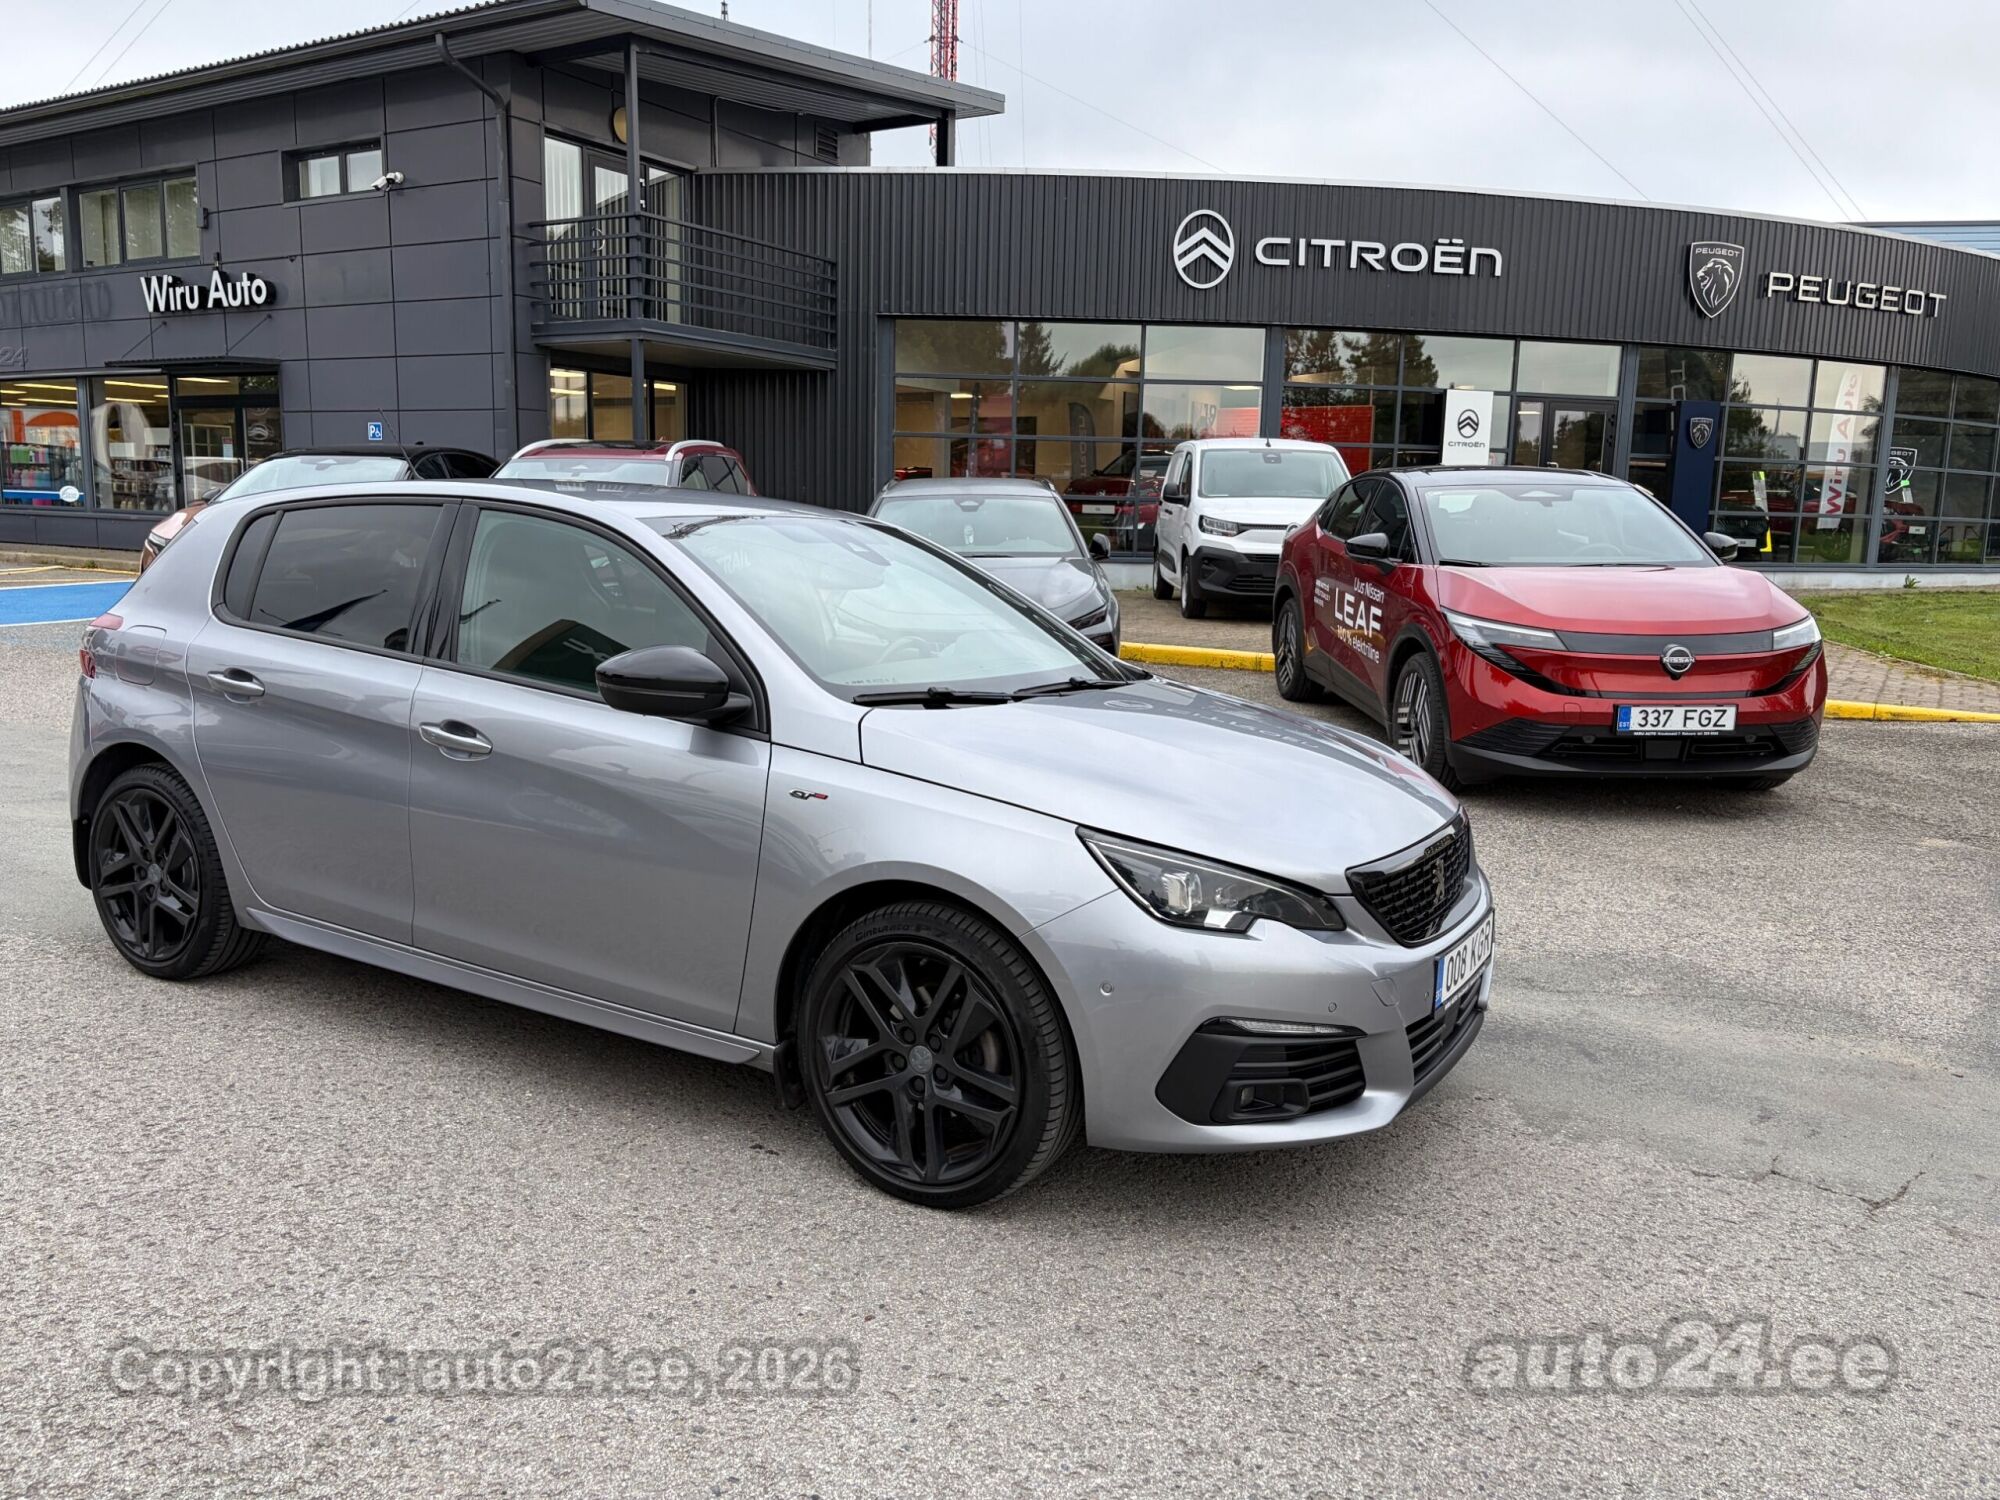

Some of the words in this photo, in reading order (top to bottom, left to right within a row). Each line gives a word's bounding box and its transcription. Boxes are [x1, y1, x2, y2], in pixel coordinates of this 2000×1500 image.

[1695, 247, 1740, 257] PEUGEOT
[140, 275, 200, 313] Wiru
[207, 270, 268, 309] Auto
[1767, 271, 1947, 318] PEUGEOT
[1335, 587, 1382, 638] LEAF
[1365, 582, 1385, 604] Nissan
[1638, 709, 1674, 728] 337
[1683, 709, 1728, 728] FGZ
[1446, 944, 1468, 992] 008
